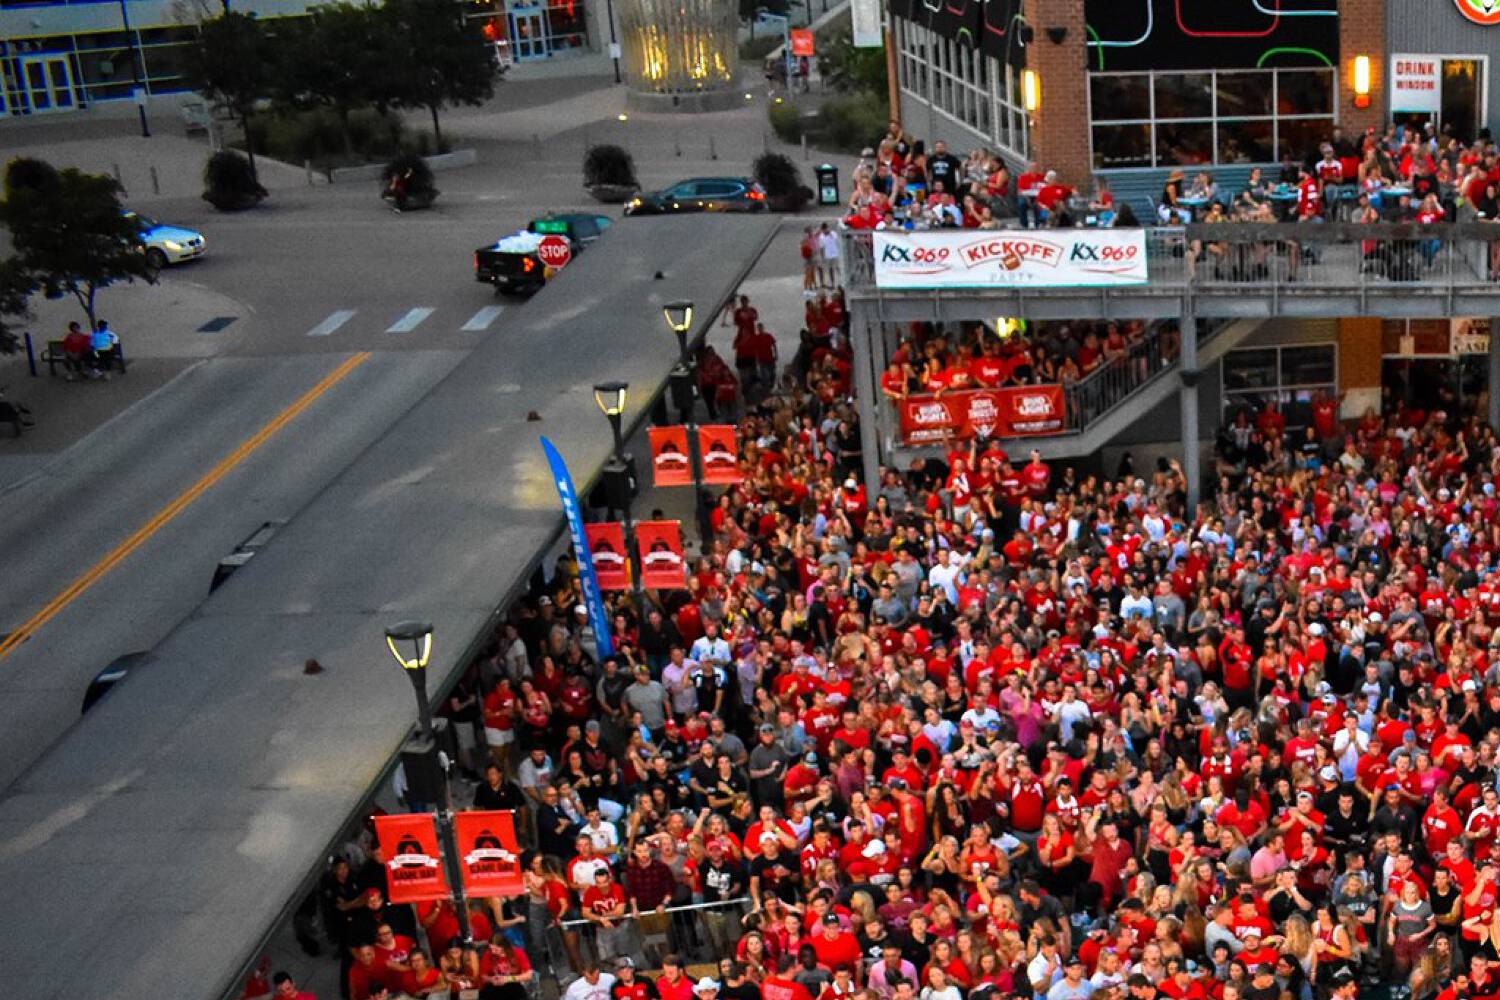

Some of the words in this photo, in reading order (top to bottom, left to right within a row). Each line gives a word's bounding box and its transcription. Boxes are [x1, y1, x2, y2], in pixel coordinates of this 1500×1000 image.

[1396, 61, 1435, 75] DRINK
[540, 246, 568, 258] STOP
[882, 243, 911, 262] KX
[966, 241, 1056, 260] KICKOFF
[1070, 241, 1099, 262] KX
